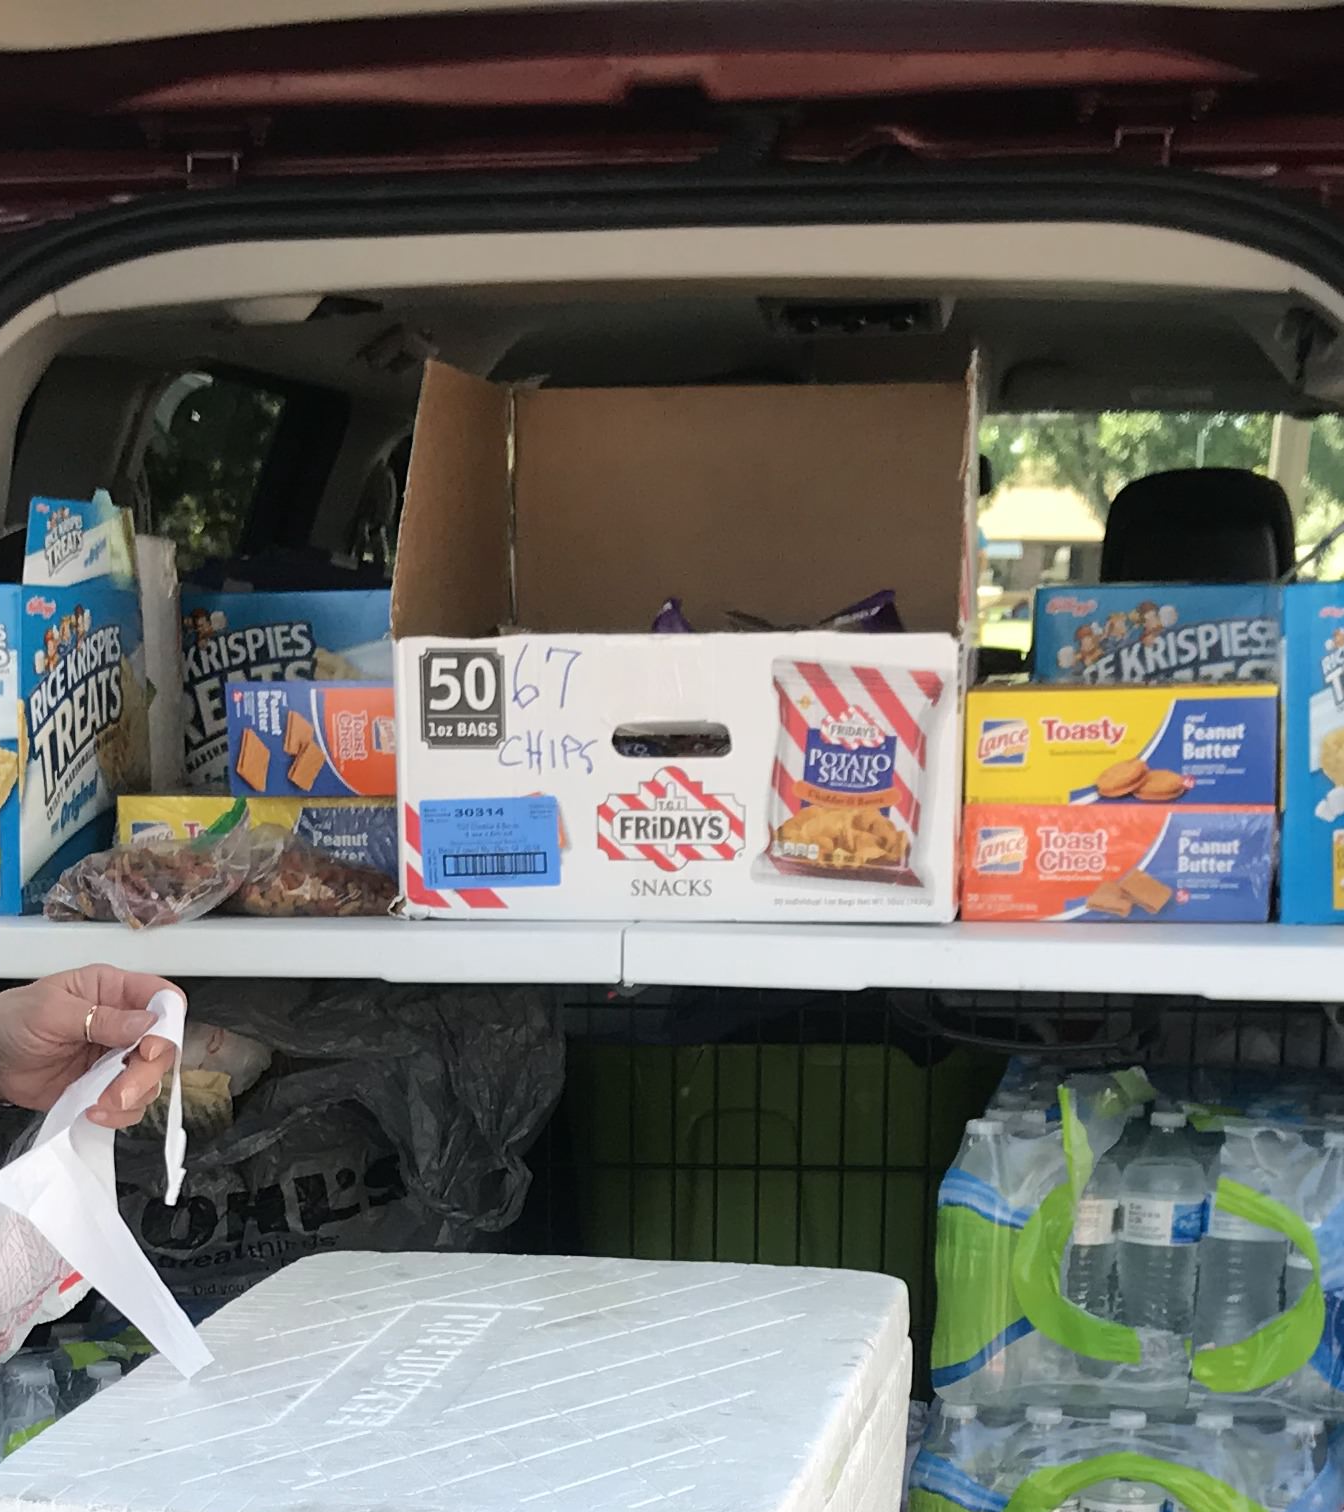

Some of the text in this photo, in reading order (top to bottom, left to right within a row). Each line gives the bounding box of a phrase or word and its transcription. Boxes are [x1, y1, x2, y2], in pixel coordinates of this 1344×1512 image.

[182, 623, 312, 682] KRISPIES
[1120, 619, 1279, 683] KRISPIES
[30, 659, 65, 733] RICE
[66, 626, 121, 690] KRISPIES
[429, 657, 496, 711] 50
[512, 643, 582, 709] 67
[34, 665, 123, 806] TREATS
[428, 722, 498, 737] 1oz BAGS
[978, 719, 1124, 760] Lance Toasty
[1183, 723, 1245, 741] Peanut
[498, 730, 598, 775] CHIPS
[809, 749, 892, 773] POTATO
[1182, 742, 1241, 760] Butter
[818, 766, 881, 787] SKINS
[454, 807, 505, 818] 30314
[312, 831, 369, 847] Peanut
[1040, 829, 1105, 850] Toast
[1178, 836, 1240, 855] Peanut
[1040, 850, 1103, 871] Chee
[1177, 855, 1235, 873] Butter
[631, 879, 713, 897] SNACKS
